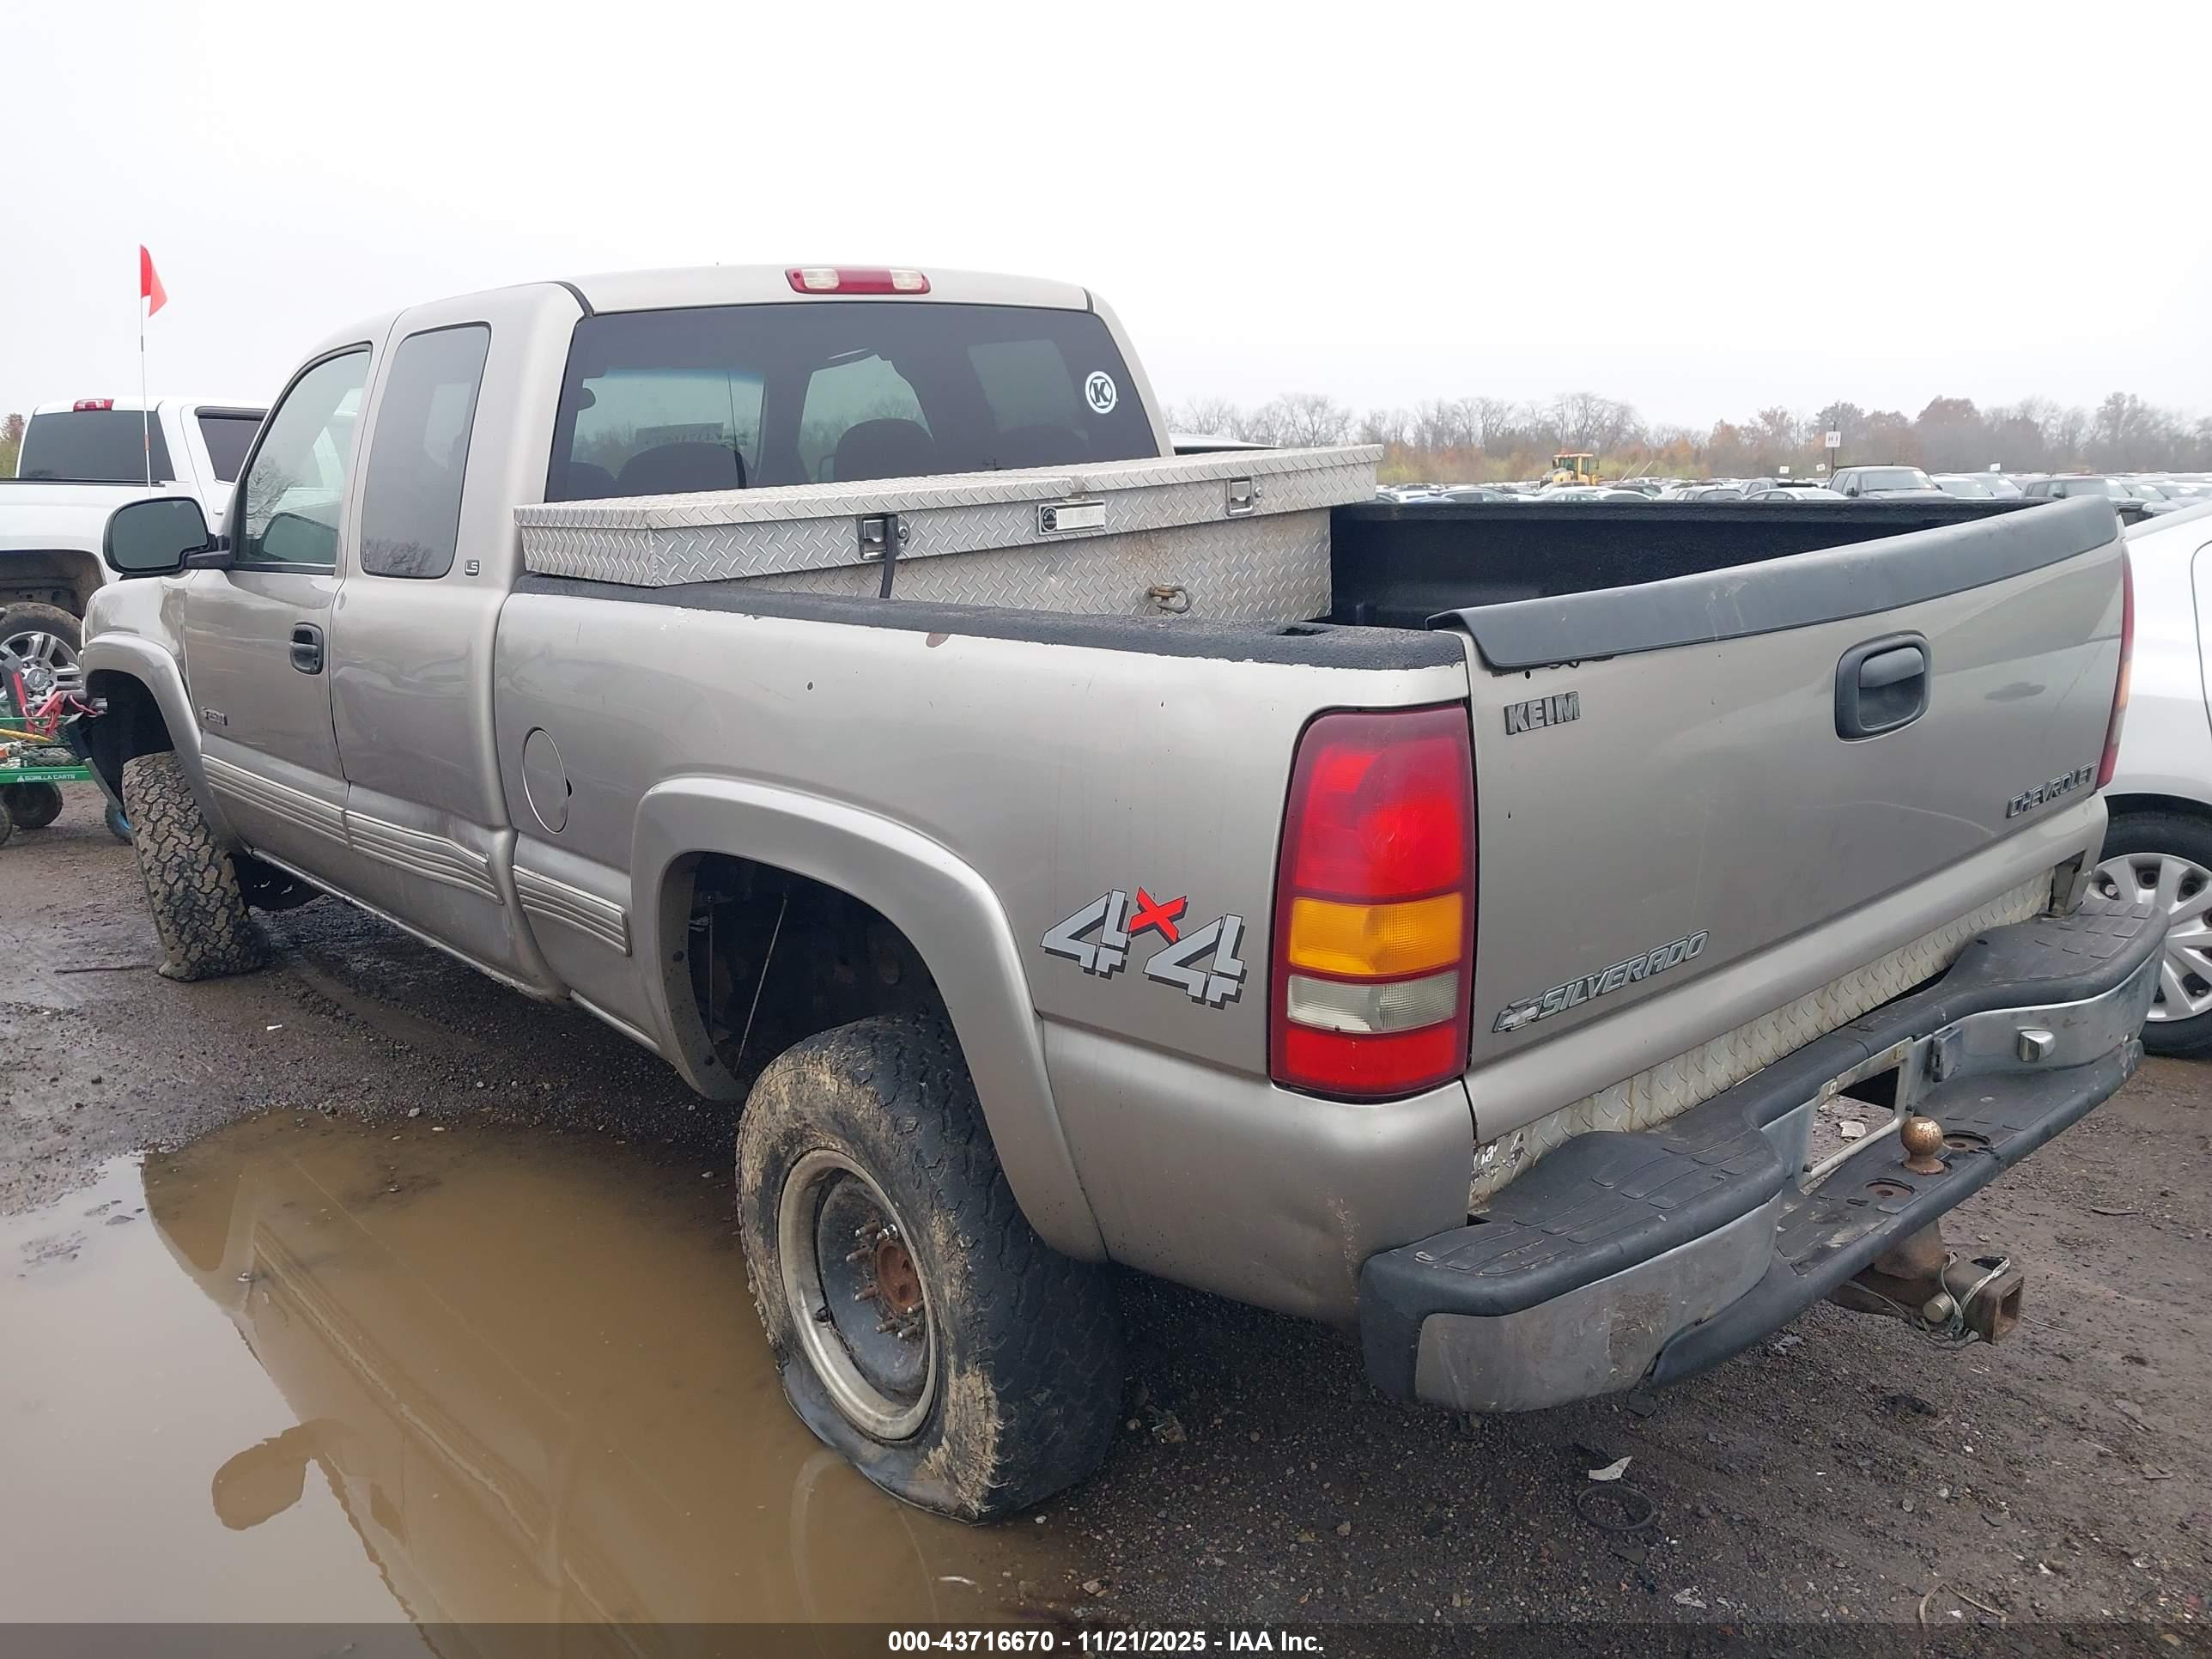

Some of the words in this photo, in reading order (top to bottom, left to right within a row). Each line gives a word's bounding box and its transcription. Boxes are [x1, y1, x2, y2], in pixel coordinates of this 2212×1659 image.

[465, 562, 478, 573] LS
[1504, 690, 1581, 735] KEIM
[2006, 761, 2098, 818] CHEVROLET
[1535, 929, 1710, 1021] SILVERADO
